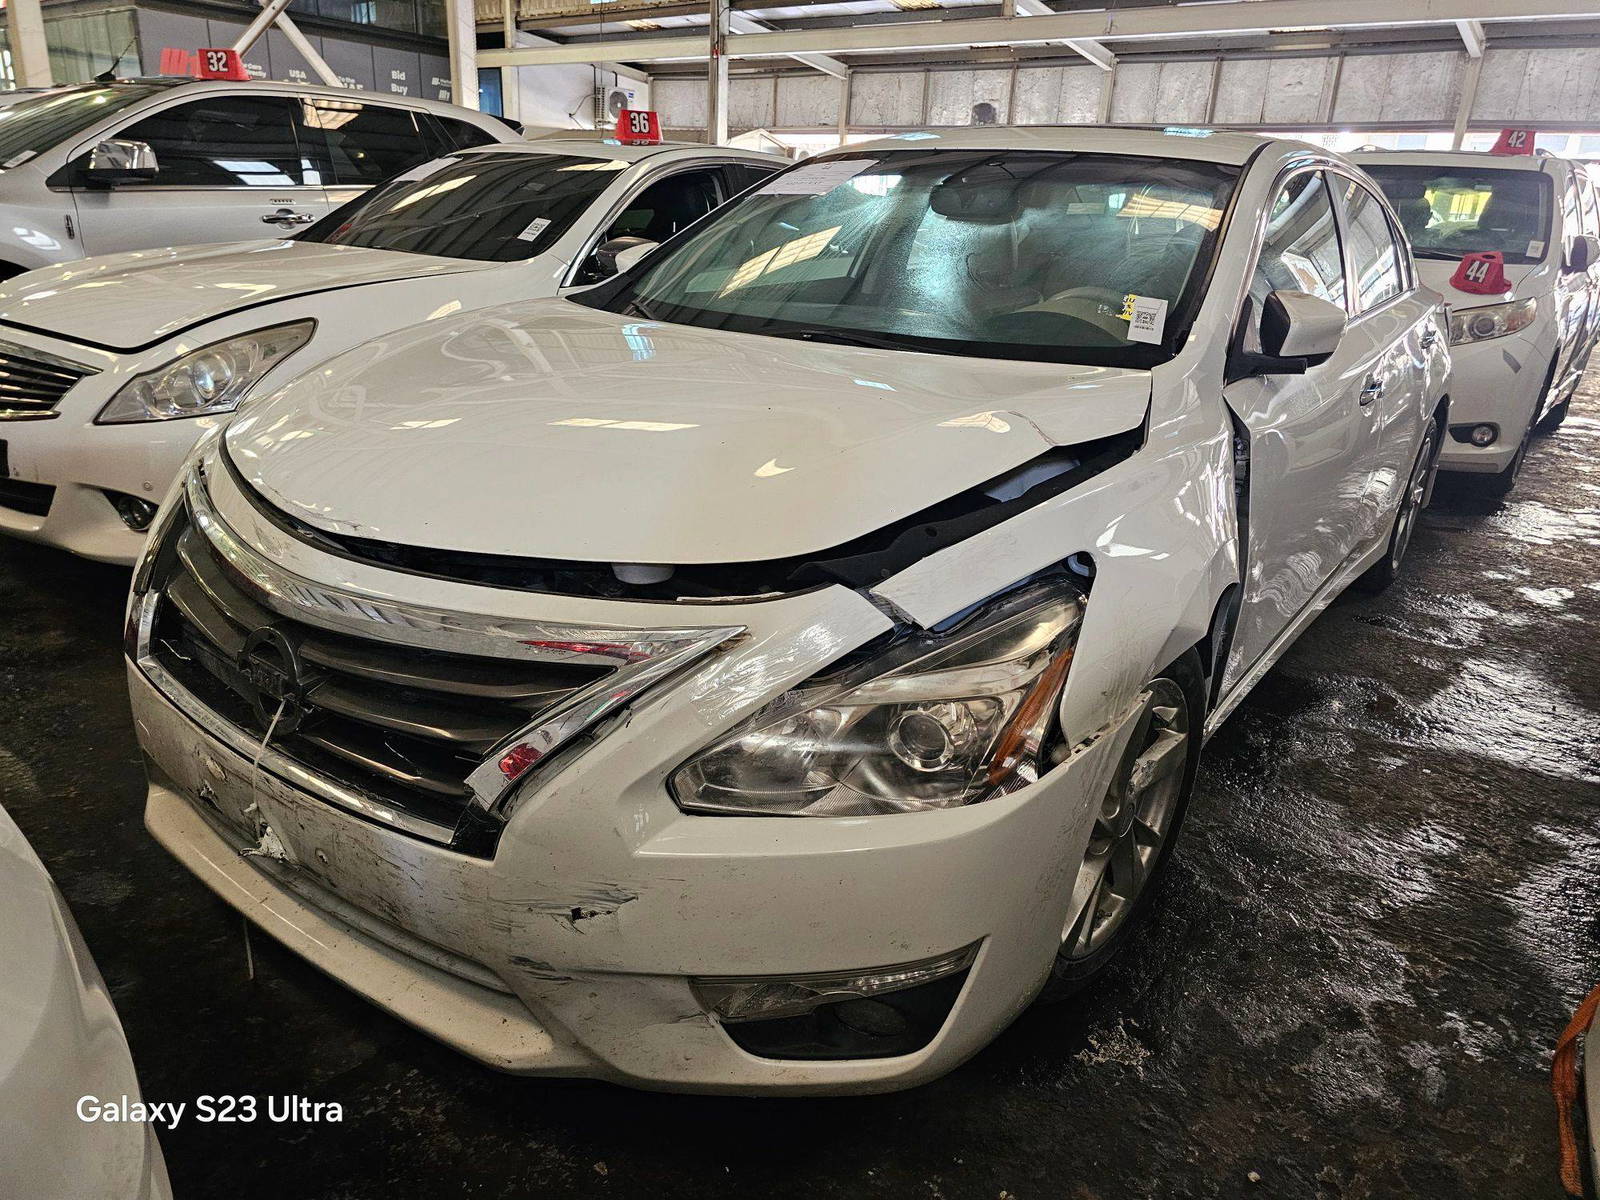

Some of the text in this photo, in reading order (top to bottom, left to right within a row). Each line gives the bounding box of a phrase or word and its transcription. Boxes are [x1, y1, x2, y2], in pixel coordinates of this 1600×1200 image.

[207, 51, 229, 72] 32
[289, 69, 307, 79] USA
[391, 70, 406, 81] Bid
[391, 83, 408, 96] Buy
[630, 112, 650, 133] 36
[1508, 130, 1527, 148] 42
[1466, 260, 1490, 283] 44
